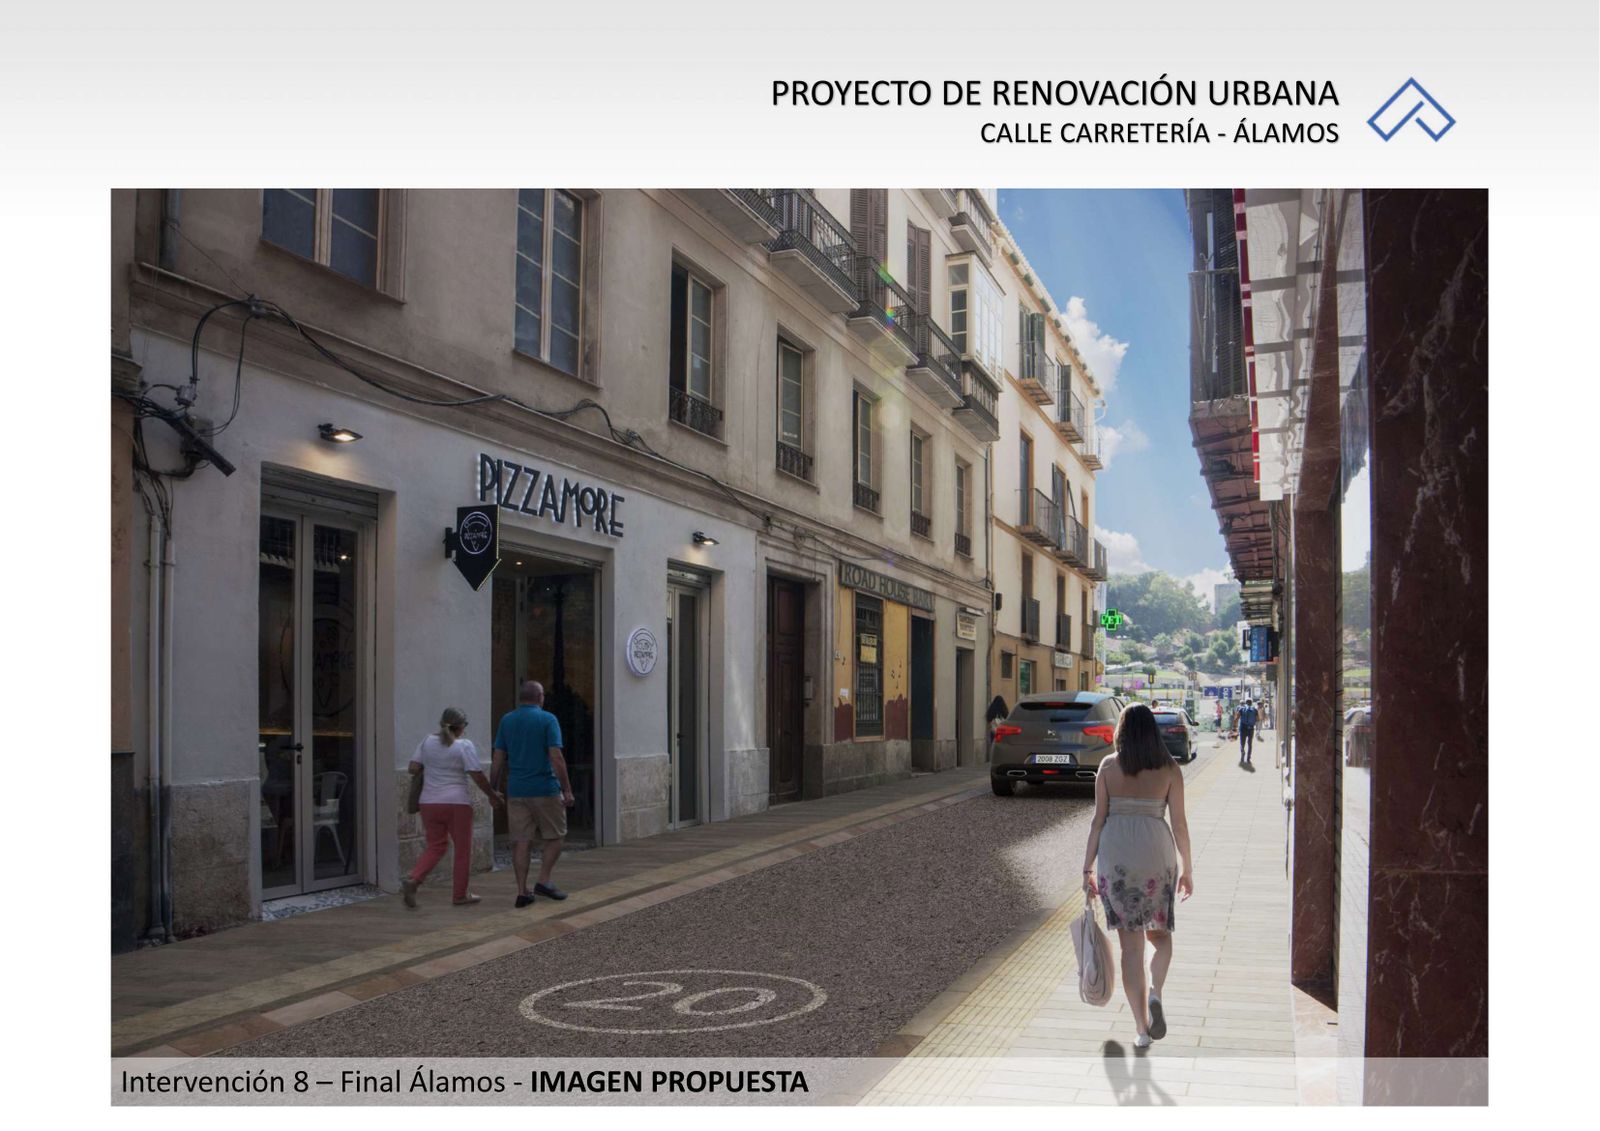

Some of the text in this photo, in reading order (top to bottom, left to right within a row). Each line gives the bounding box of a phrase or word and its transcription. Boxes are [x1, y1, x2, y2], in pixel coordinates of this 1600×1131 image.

[479, 453, 625, 538] PIZZAMORE
[845, 562, 876, 590] ROAD
[562, 980, 777, 1016] 20
